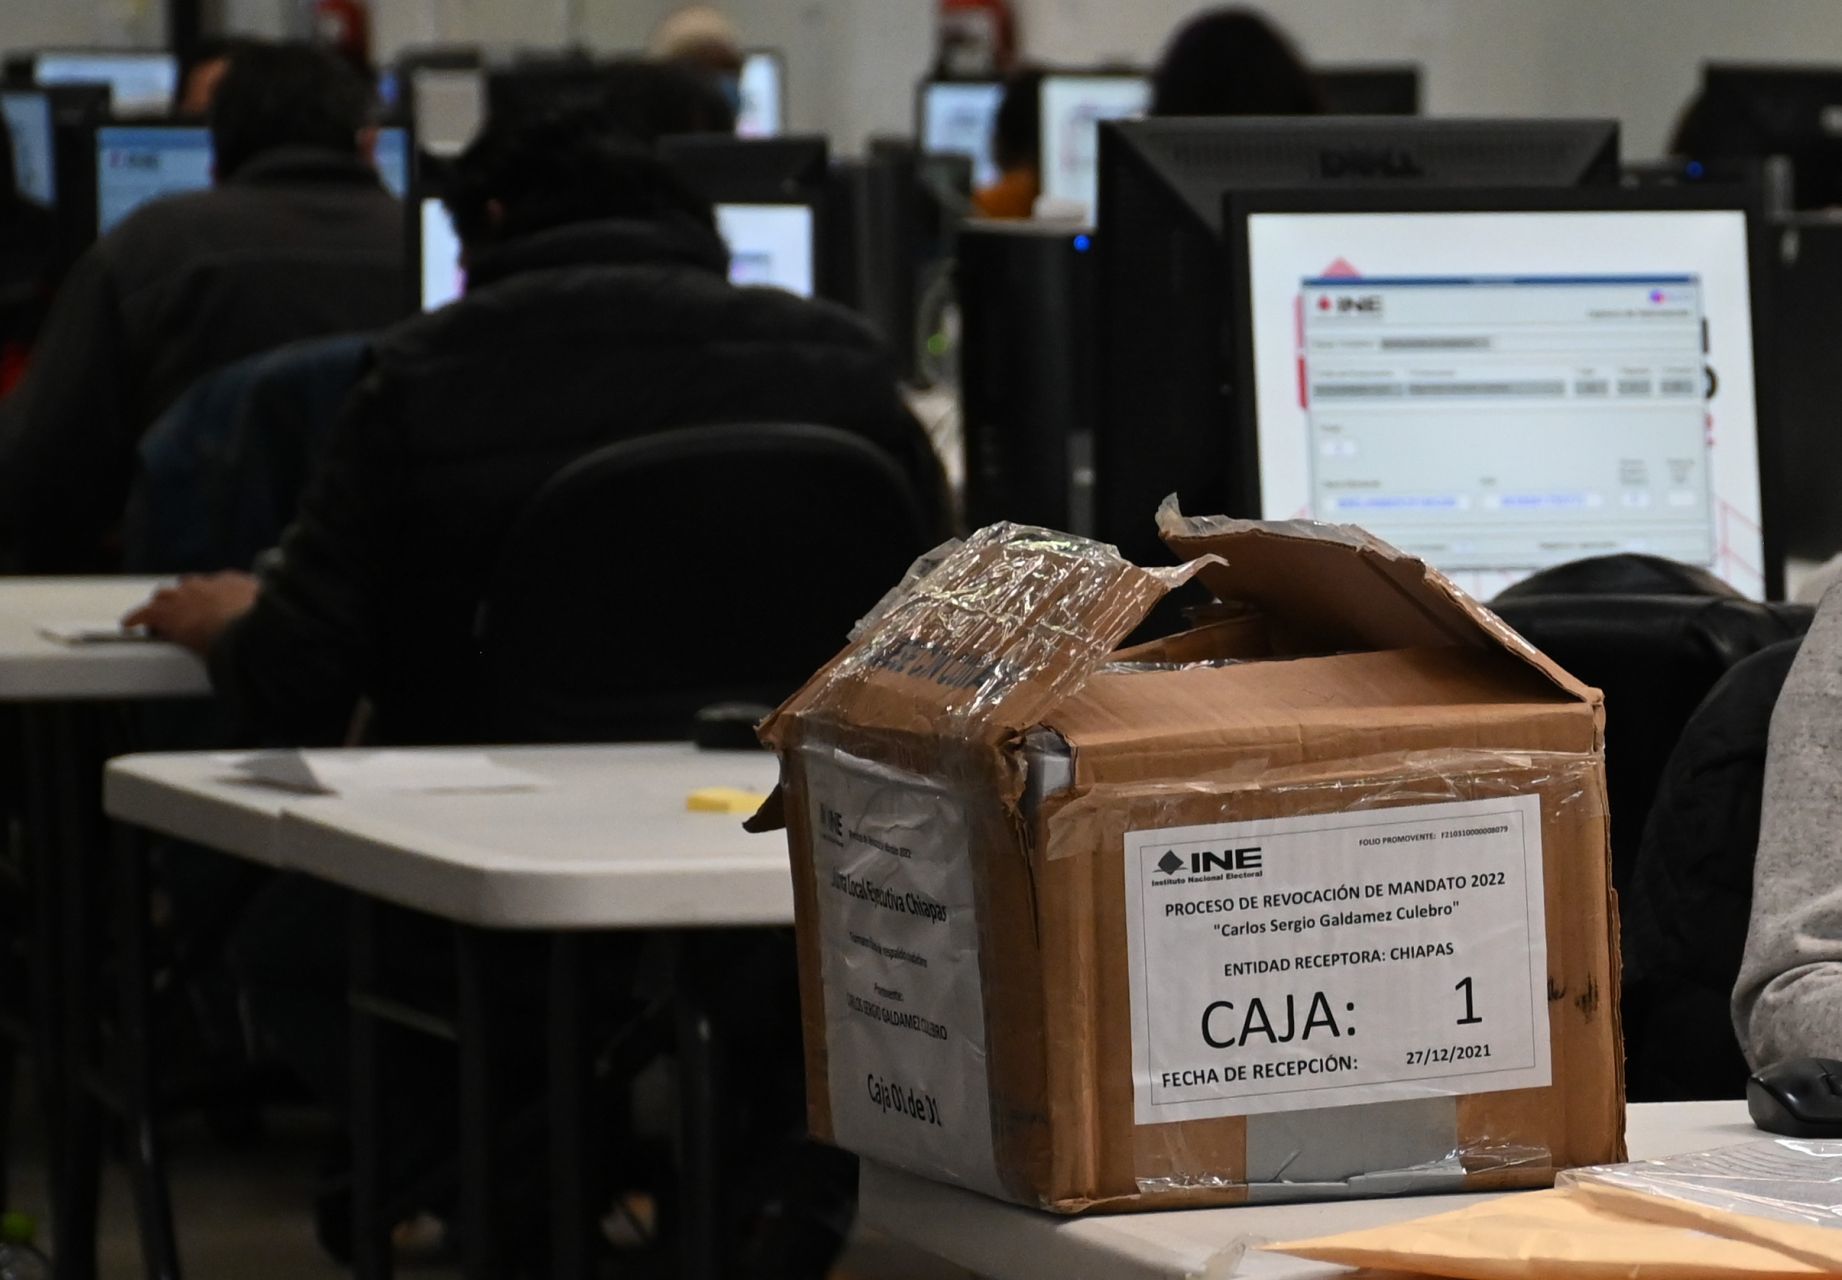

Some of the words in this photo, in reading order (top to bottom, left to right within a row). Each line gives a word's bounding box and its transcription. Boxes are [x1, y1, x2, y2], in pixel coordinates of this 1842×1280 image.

[1337, 296, 1382, 312] INE
[1359, 838, 1380, 846] FOLIO
[1383, 833, 1437, 844] PROMOVENTE:
[1191, 847, 1263, 873] INE
[1152, 878, 1185, 886] Instituto
[1188, 874, 1223, 883] Nacional
[1225, 870, 1263, 880] Electoral
[1166, 899, 1234, 916] PROCESO
[1239, 897, 1258, 910] DE
[1264, 884, 1359, 907] REVOCACIÓN
[1365, 884, 1383, 898] DE
[1389, 876, 1466, 895] MANDATO
[1472, 872, 1505, 887] 2022
[848, 873, 868, 901] Local
[867, 881, 905, 912] Ejecutiva
[905, 892, 948, 924] Chiapas
[1214, 921, 1266, 936] "Carlos
[1271, 917, 1315, 933] Sergio
[1320, 912, 1392, 927] Galdamez
[1397, 901, 1459, 920] Culebro"
[1225, 959, 1290, 976] ENTIDAD
[1295, 950, 1385, 969] RECEPTORA:
[1391, 943, 1453, 960] CHIAPAS
[1202, 992, 1355, 1048] CAJA:
[1455, 977, 1482, 1024] 1
[1162, 1069, 1219, 1087] FECHA
[1225, 1066, 1246, 1081] DE
[1253, 1055, 1357, 1079] RECEPCIÓN:
[1407, 1045, 1490, 1065] 27/12/2021
[867, 1073, 891, 1114] Caja
[891, 1083, 908, 1115] 01
[908, 1087, 926, 1122] de
